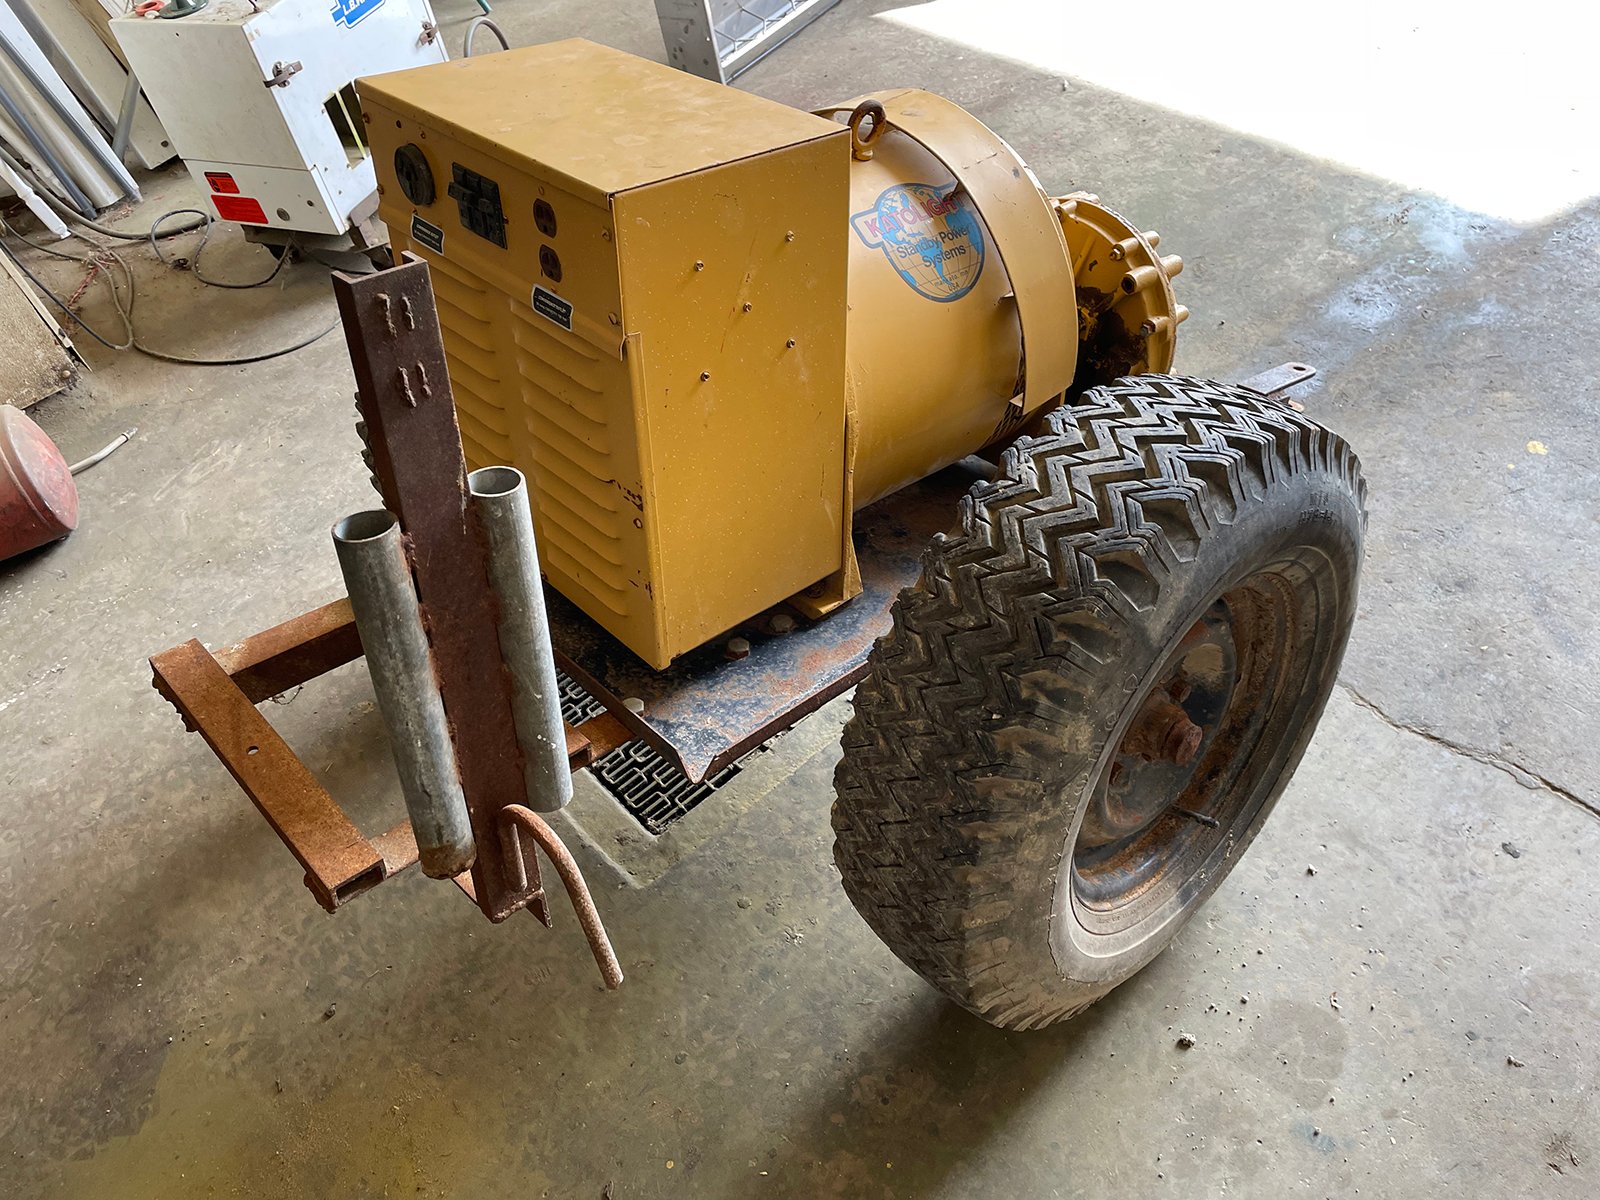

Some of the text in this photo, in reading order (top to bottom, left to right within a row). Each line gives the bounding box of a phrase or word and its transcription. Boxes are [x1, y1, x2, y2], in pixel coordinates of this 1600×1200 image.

[896, 223, 970, 259] Standby Power
[922, 244, 966, 268] Systems
